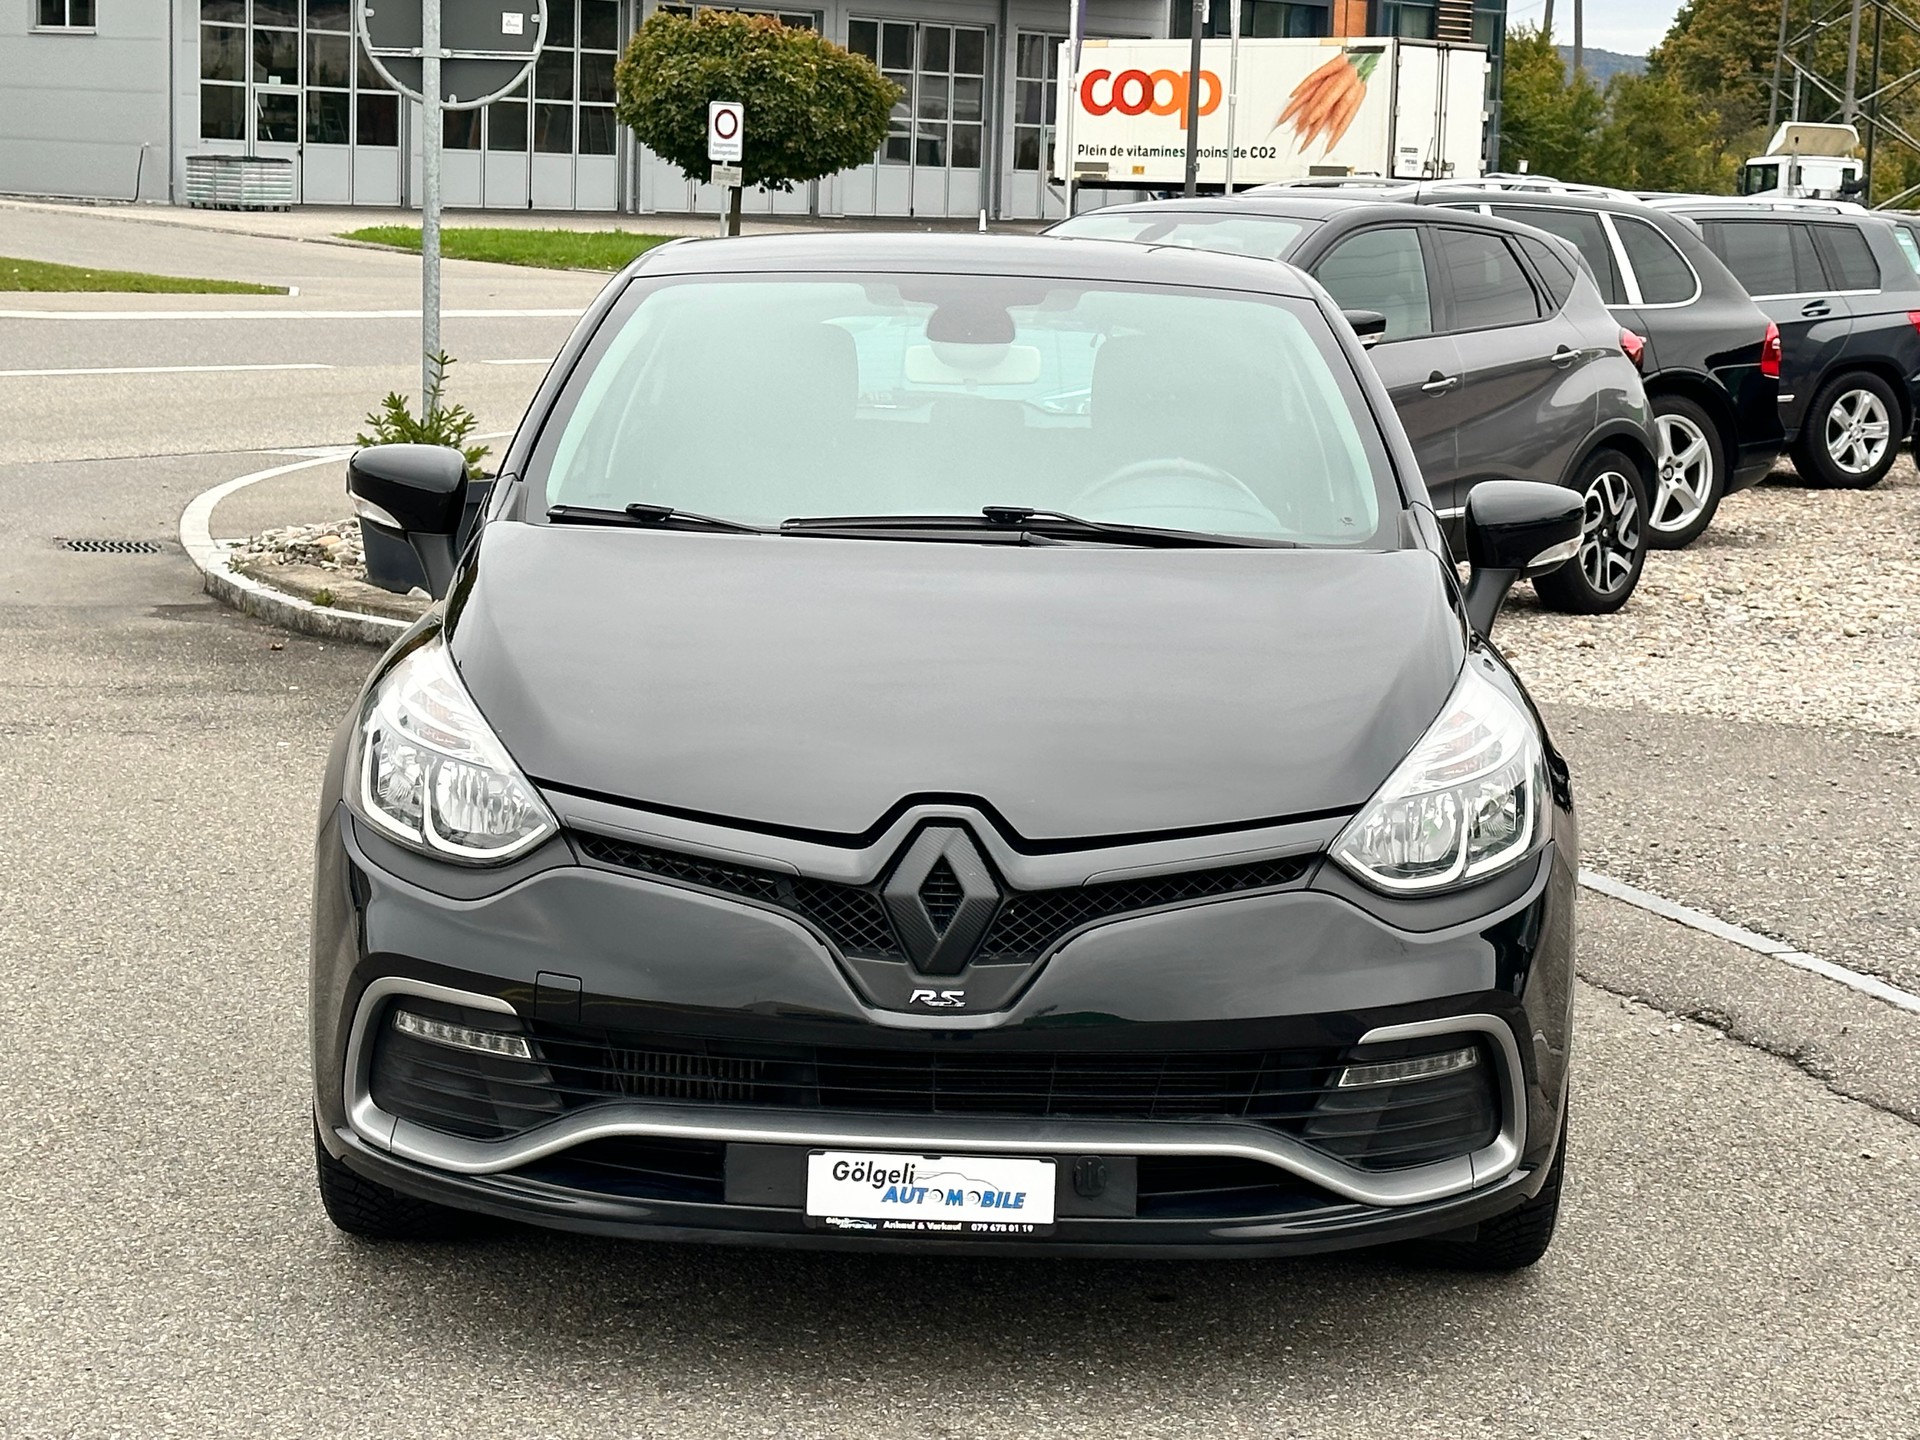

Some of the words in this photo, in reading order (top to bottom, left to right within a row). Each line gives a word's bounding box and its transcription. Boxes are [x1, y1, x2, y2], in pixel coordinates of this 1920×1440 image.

[1080, 69, 1222, 129] coop
[1078, 144, 1107, 156] Plein
[1110, 145, 1124, 157] de
[1127, 145, 1186, 157] vitamines
[1233, 146, 1247, 158] de
[1250, 146, 1277, 159] CO2
[909, 989, 966, 1008] RS
[832, 1160, 916, 1189] Gölgeli
[881, 1185, 1026, 1209] AUTOMOBILE
[971, 1223, 988, 1232] 079
[1008, 1224, 1019, 1232] 01
